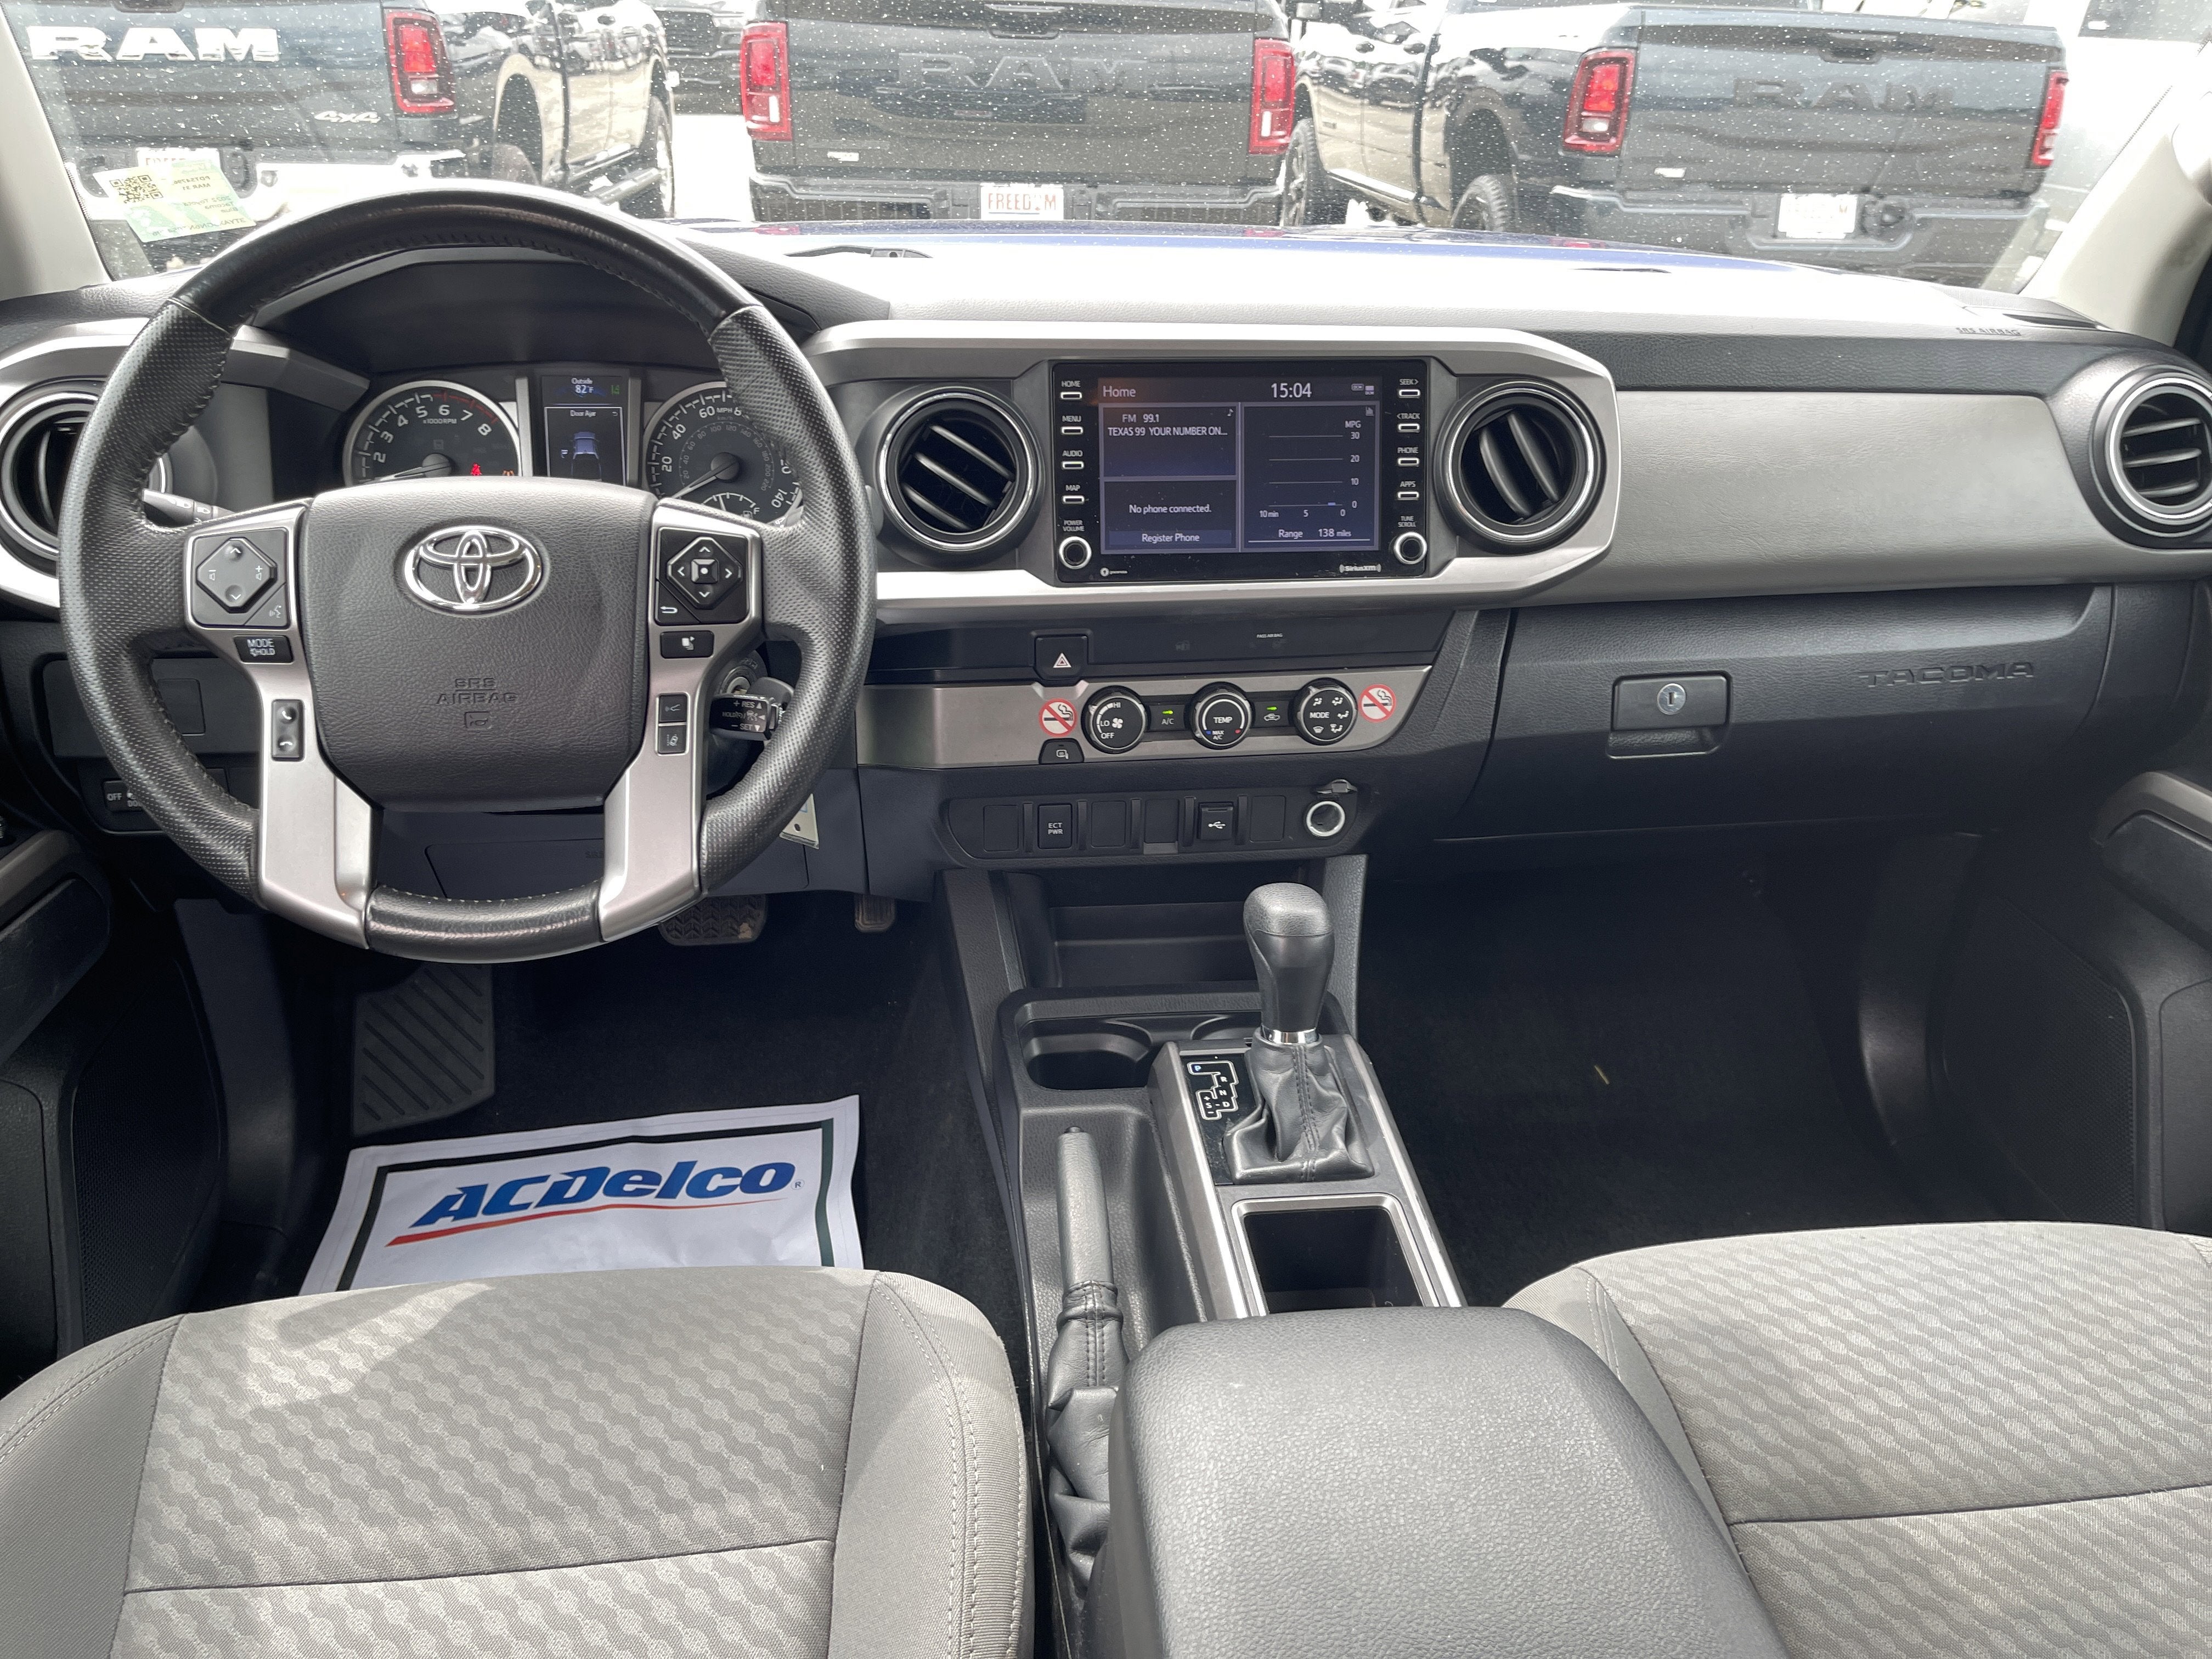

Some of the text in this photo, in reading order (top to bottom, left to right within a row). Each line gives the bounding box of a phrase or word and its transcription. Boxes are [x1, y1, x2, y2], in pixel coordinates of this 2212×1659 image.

[27, 26, 279, 61] RAM
[899, 53, 1147, 92] RAM
[1734, 77, 1954, 110] RAM
[988, 193, 1056, 211] FREEDM
[1103, 386, 1136, 397] Home
[1271, 382, 1312, 398] 15:04
[415, 405, 428, 417] 5
[439, 404, 450, 416] 6
[461, 409, 473, 421] 7
[699, 406, 715, 418] 60
[397, 414, 409, 427] 4
[1122, 414, 1160, 422] FM 99.1
[478, 423, 492, 436] 8
[672, 424, 686, 439] 40
[697, 431, 707, 439] 80
[1108, 427, 1133, 436] TEXAS
[1135, 427, 1146, 436] 99
[1149, 427, 1171, 436] YOUR
[1172, 426, 1207, 436] NUMBER
[380, 431, 394, 443] 3
[687, 441, 696, 450] 60
[373, 452, 386, 463] 2
[682, 455, 690, 465] 40
[661, 456, 673, 472] 20
[682, 470, 690, 479] 20
[771, 489, 788, 508] 140
[1351, 500, 1358, 509] 0
[1129, 504, 1212, 515] No phone connected.
[1142, 533, 1200, 544] Register Phone
[1278, 529, 1304, 539] Range
[1318, 529, 1335, 537] 138
[247, 639, 274, 647] MODE
[1859, 662, 2034, 687] TACOMA
[455, 678, 496, 688] SRS
[436, 692, 518, 704] AIRBAG
[107, 793, 122, 801] OFF
[408, 1160, 795, 1228] ACDelco
